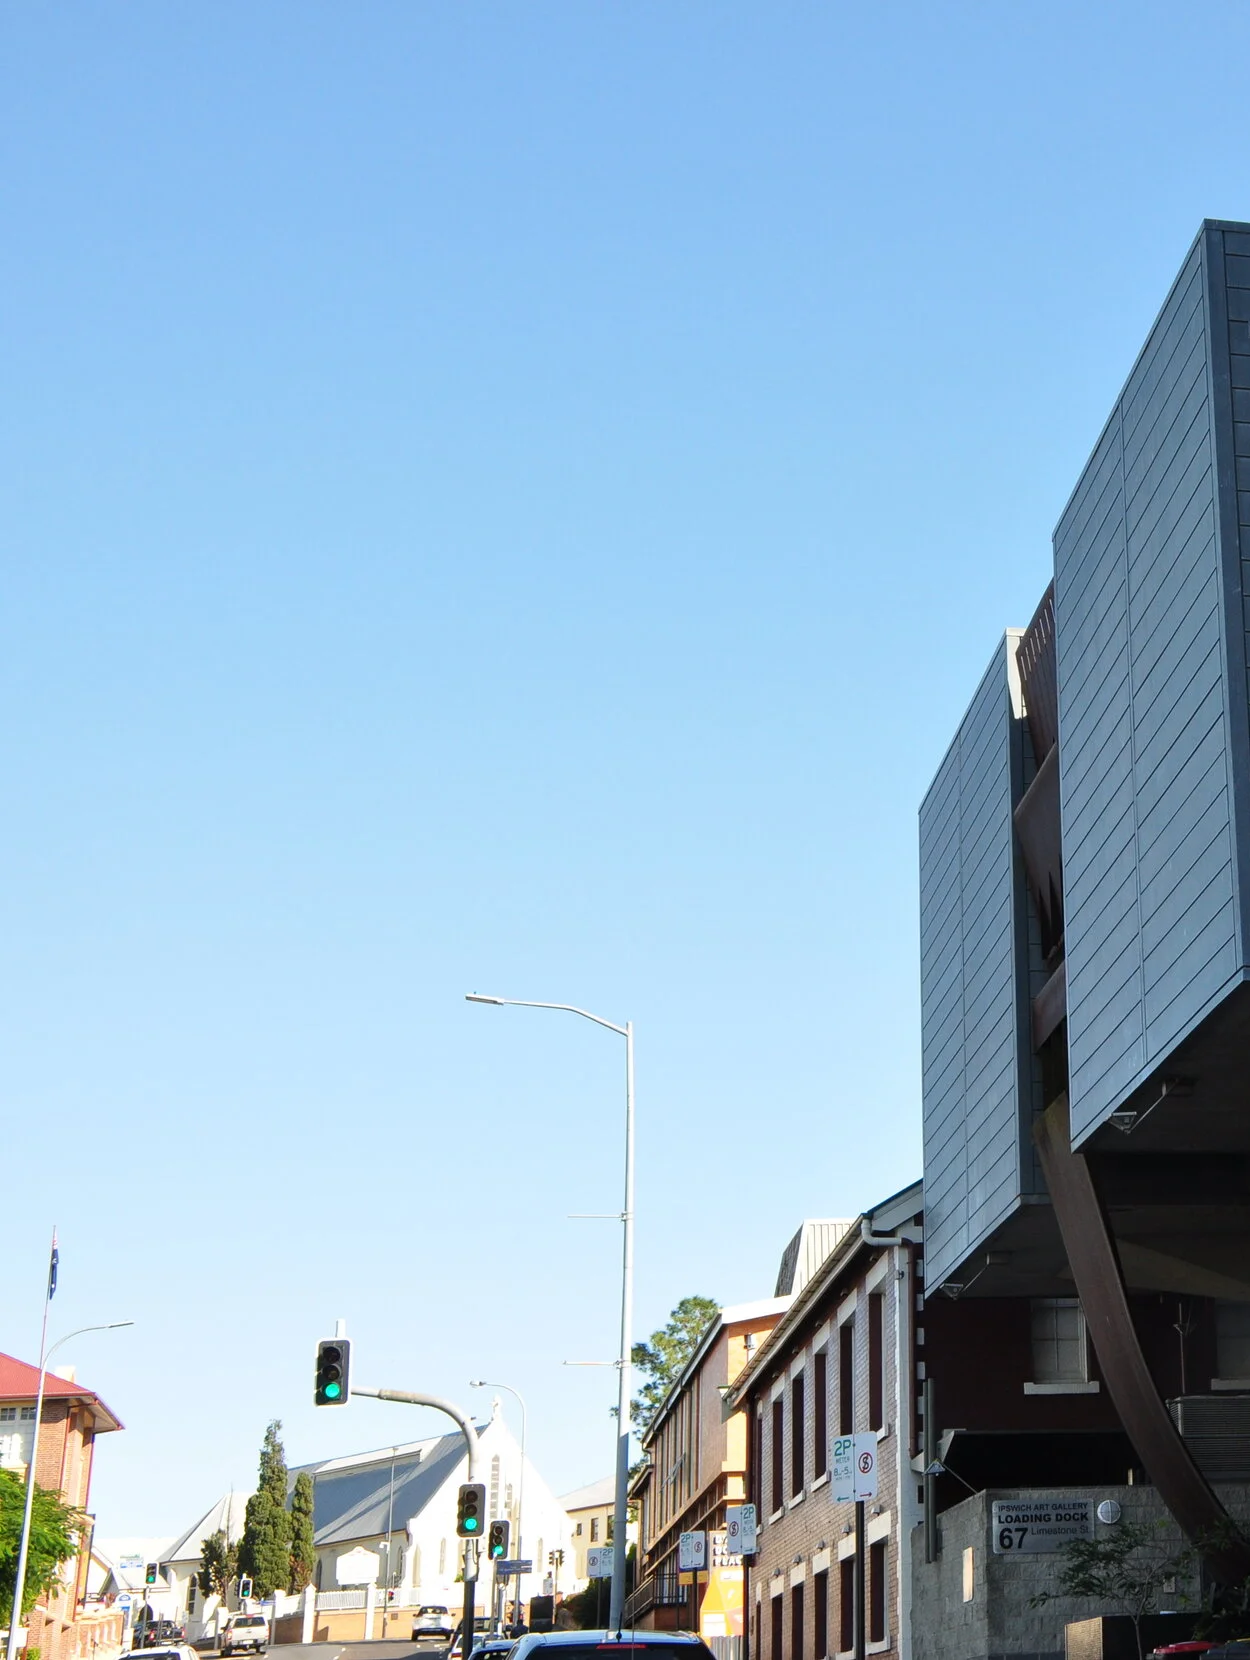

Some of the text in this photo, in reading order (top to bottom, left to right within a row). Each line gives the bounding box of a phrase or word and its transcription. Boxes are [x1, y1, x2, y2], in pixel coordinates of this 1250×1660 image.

[834, 1439, 852, 1456] 2P
[743, 1506, 755, 1519] 2P
[998, 1502, 1088, 1512] IPSWICH ART GALLERY
[998, 1512, 1088, 1524] LOADING DOCK
[681, 1533, 691, 1543] 2P
[1000, 1525, 1089, 1549] 67 Limestone St
[602, 1548, 613, 1556] 2P
